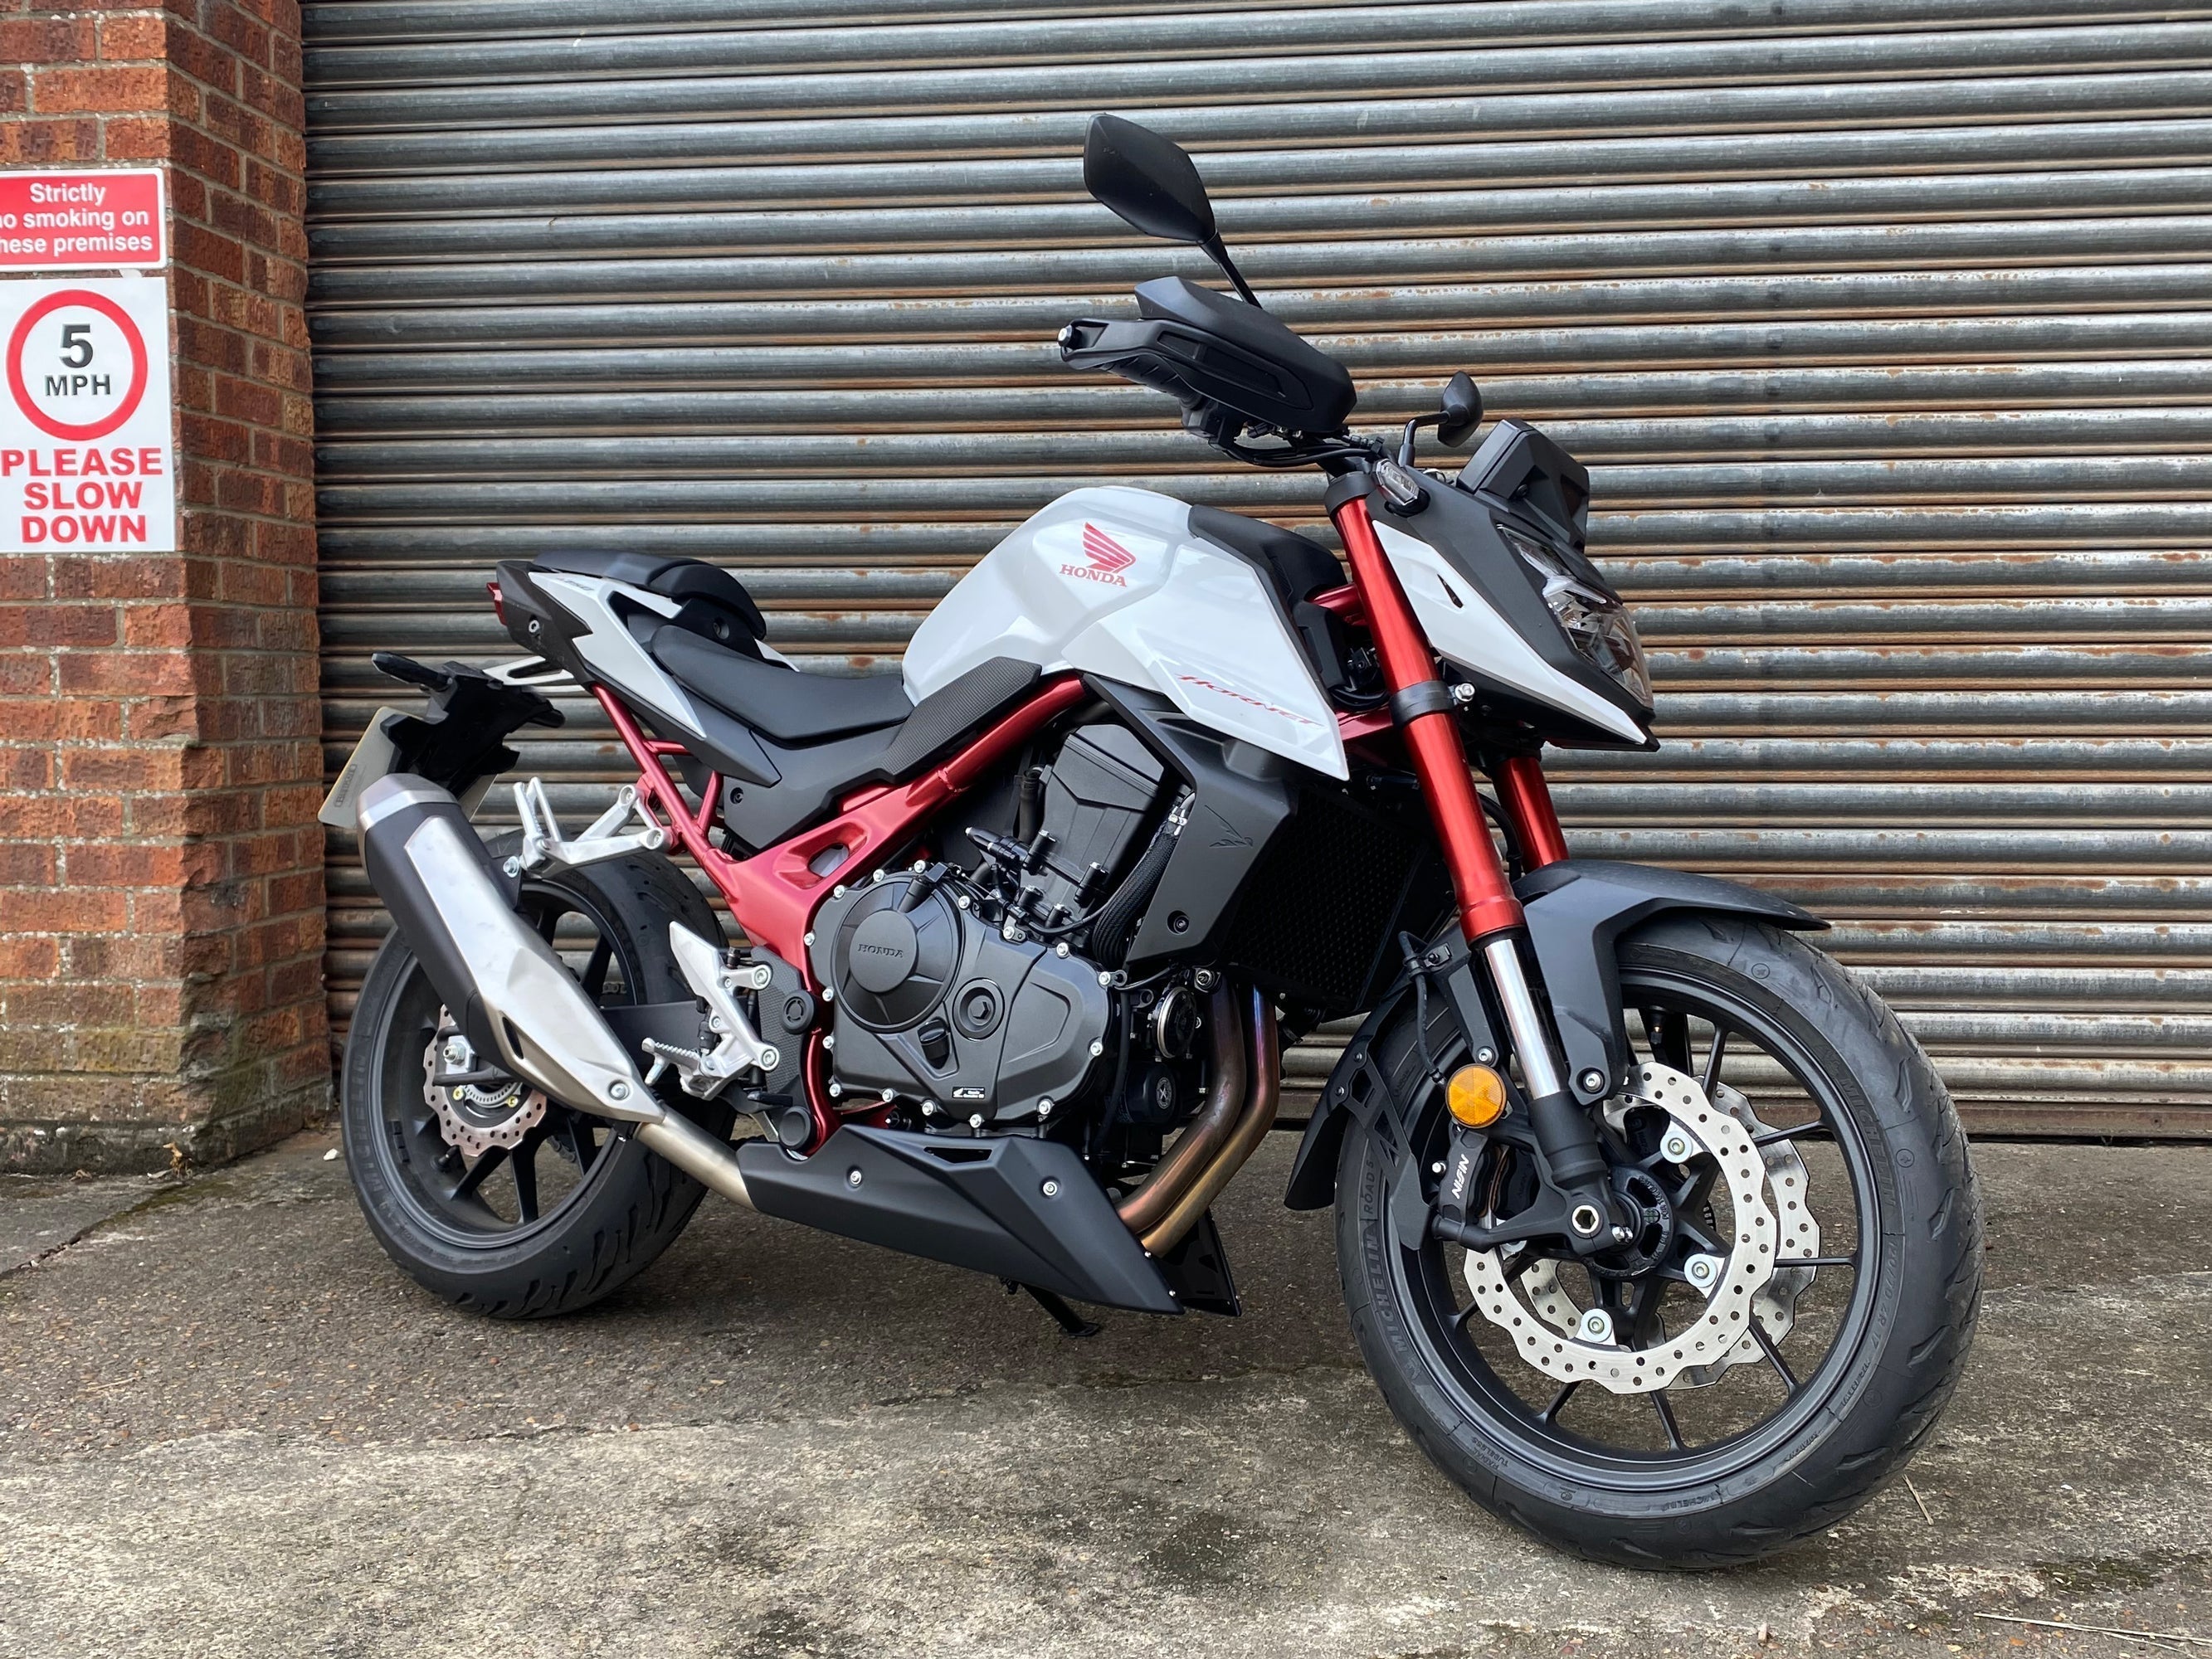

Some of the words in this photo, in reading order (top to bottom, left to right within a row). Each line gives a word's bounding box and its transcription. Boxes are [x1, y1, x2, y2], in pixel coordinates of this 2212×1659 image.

[30, 182, 106, 207] Strictly
[22, 207, 115, 231] smoking
[121, 211, 149, 226] on
[0, 236, 46, 254] hese
[53, 232, 153, 257] premises
[59, 324, 94, 368] 5
[45, 374, 111, 396] MPH
[0, 448, 163, 476] PLEASE
[23, 481, 143, 510] SLOW
[22, 515, 146, 543] DOWN
[1060, 564, 1127, 587] HONDA
[857, 943, 904, 958] HONDA
[1839, 1078, 1897, 1207] MICHELIN
[1366, 1160, 1374, 1169] 5
[1363, 1172, 1375, 1215] ROAD
[1367, 1233, 1408, 1354] MICHELIN
[1871, 1333, 1882, 1350] 17
